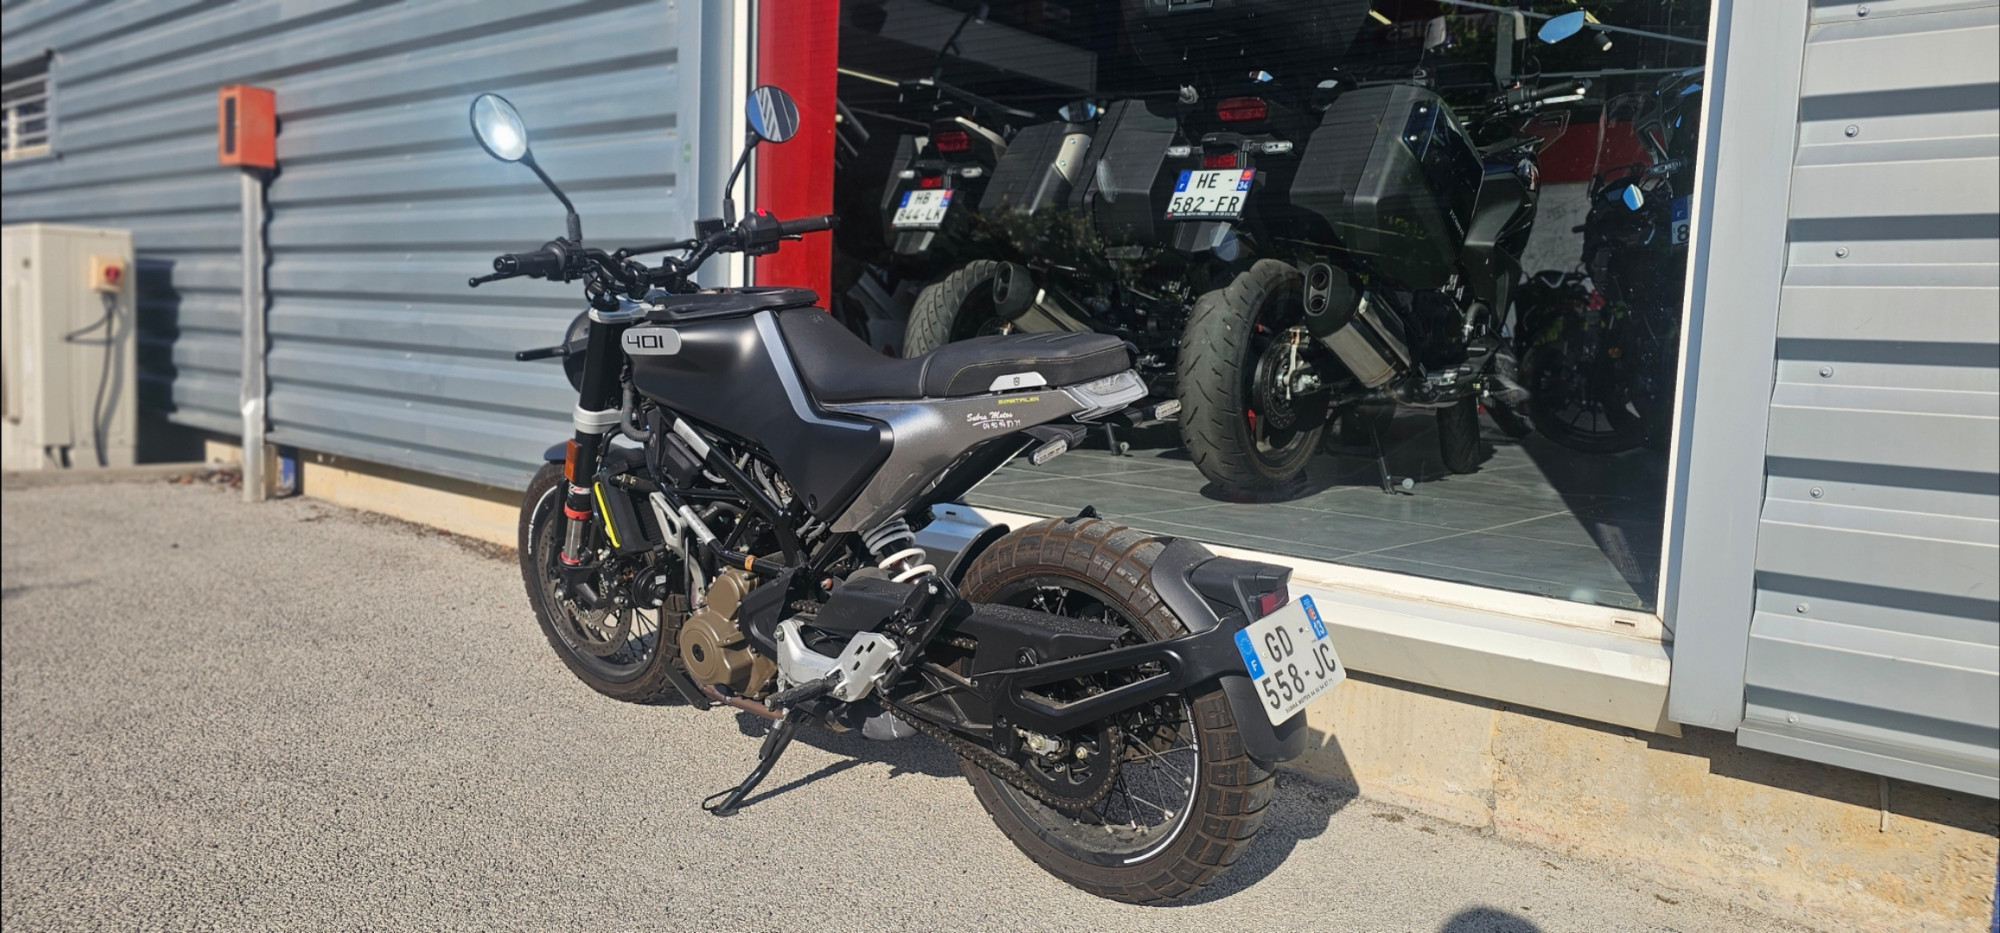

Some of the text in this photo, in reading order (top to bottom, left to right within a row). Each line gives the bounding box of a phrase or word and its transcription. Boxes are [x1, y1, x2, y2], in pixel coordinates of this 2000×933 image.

[1196, 173, 1220, 189] HE
[1238, 181, 1249, 190] 34
[914, 192, 931, 205] HB
[627, 335, 664, 348] 401
[1313, 620, 1325, 637] 13
[1264, 625, 1294, 663] GD
[1251, 659, 1258, 672] F
